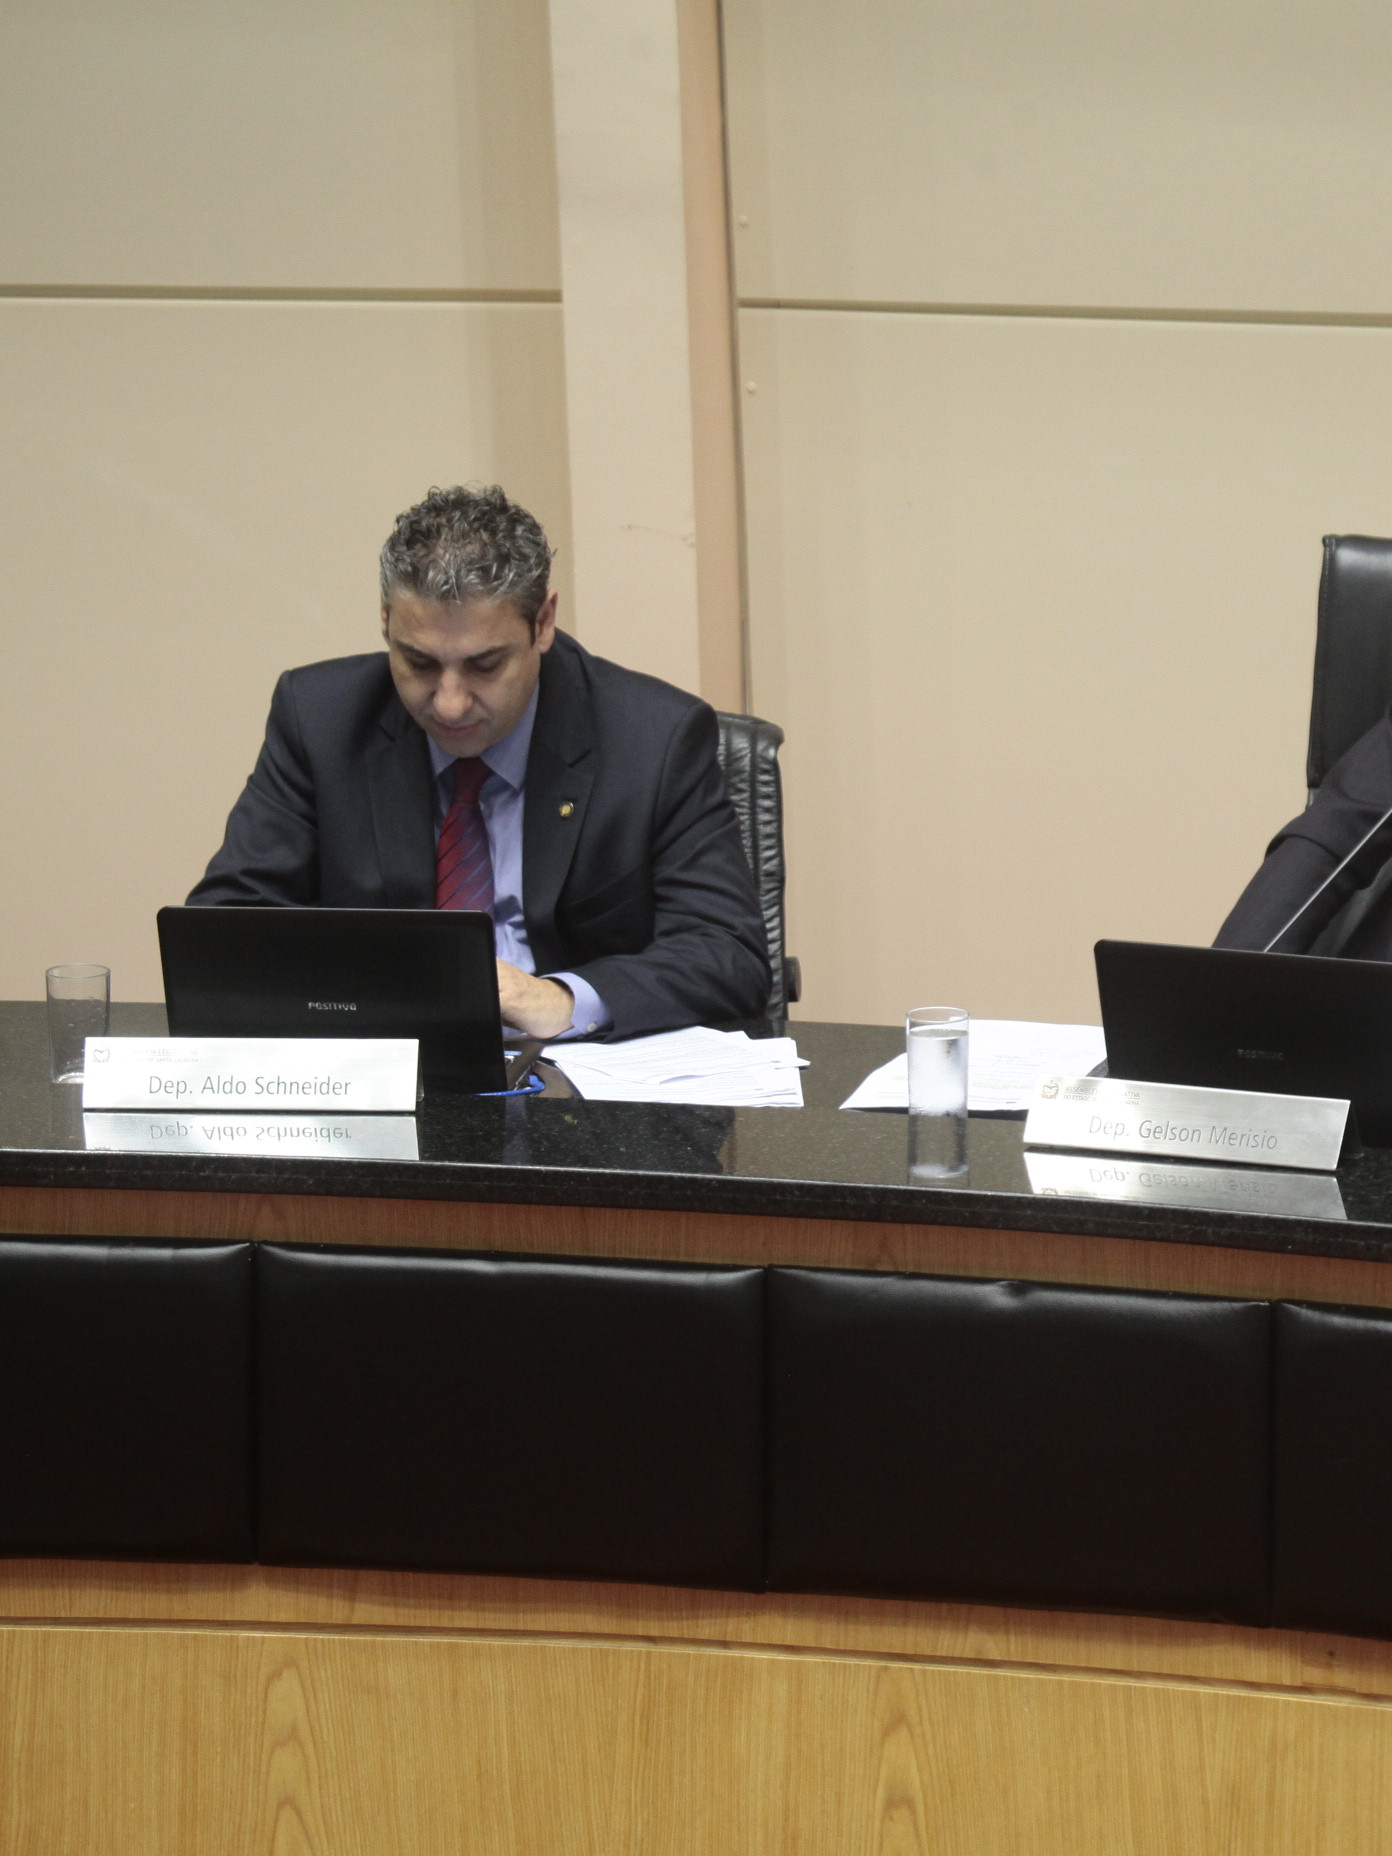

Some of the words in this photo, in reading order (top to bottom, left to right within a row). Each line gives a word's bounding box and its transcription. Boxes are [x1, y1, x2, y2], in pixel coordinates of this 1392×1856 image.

[149, 1075, 193, 1100] Dep.
[200, 1075, 248, 1096] Aldo
[254, 1075, 352, 1096] Schneider
[1089, 1115, 1130, 1141] Dep.
[1138, 1119, 1202, 1143] Gelson
[1208, 1125, 1279, 1150] Merisio
